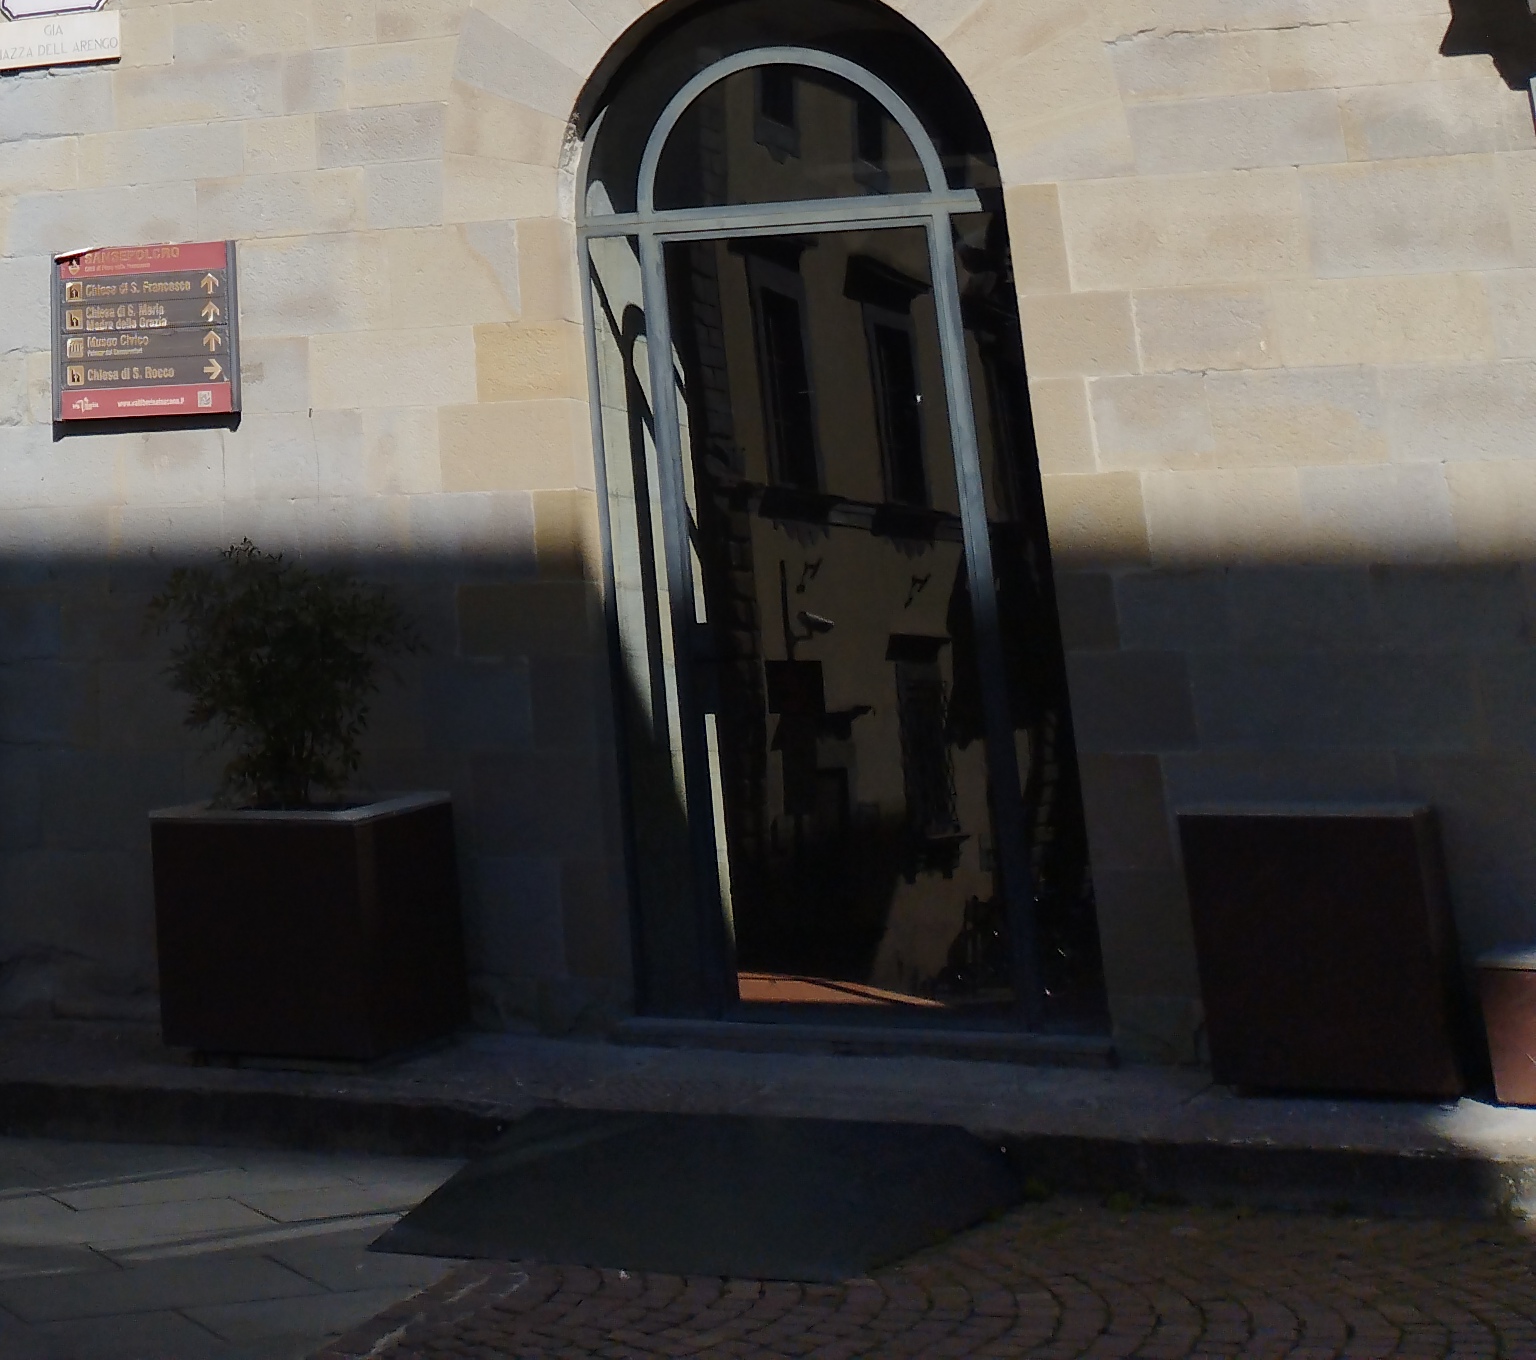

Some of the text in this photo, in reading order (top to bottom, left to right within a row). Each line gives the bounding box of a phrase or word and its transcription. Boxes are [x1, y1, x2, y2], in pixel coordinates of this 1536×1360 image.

[73, 36, 118, 53] ARENGO
[130, 281, 140, 294] S.
[142, 280, 191, 293] Francesco
[117, 304, 126, 317] di
[120, 334, 149, 346] Civico
[87, 365, 175, 381] Chiesa di S. Rocco
